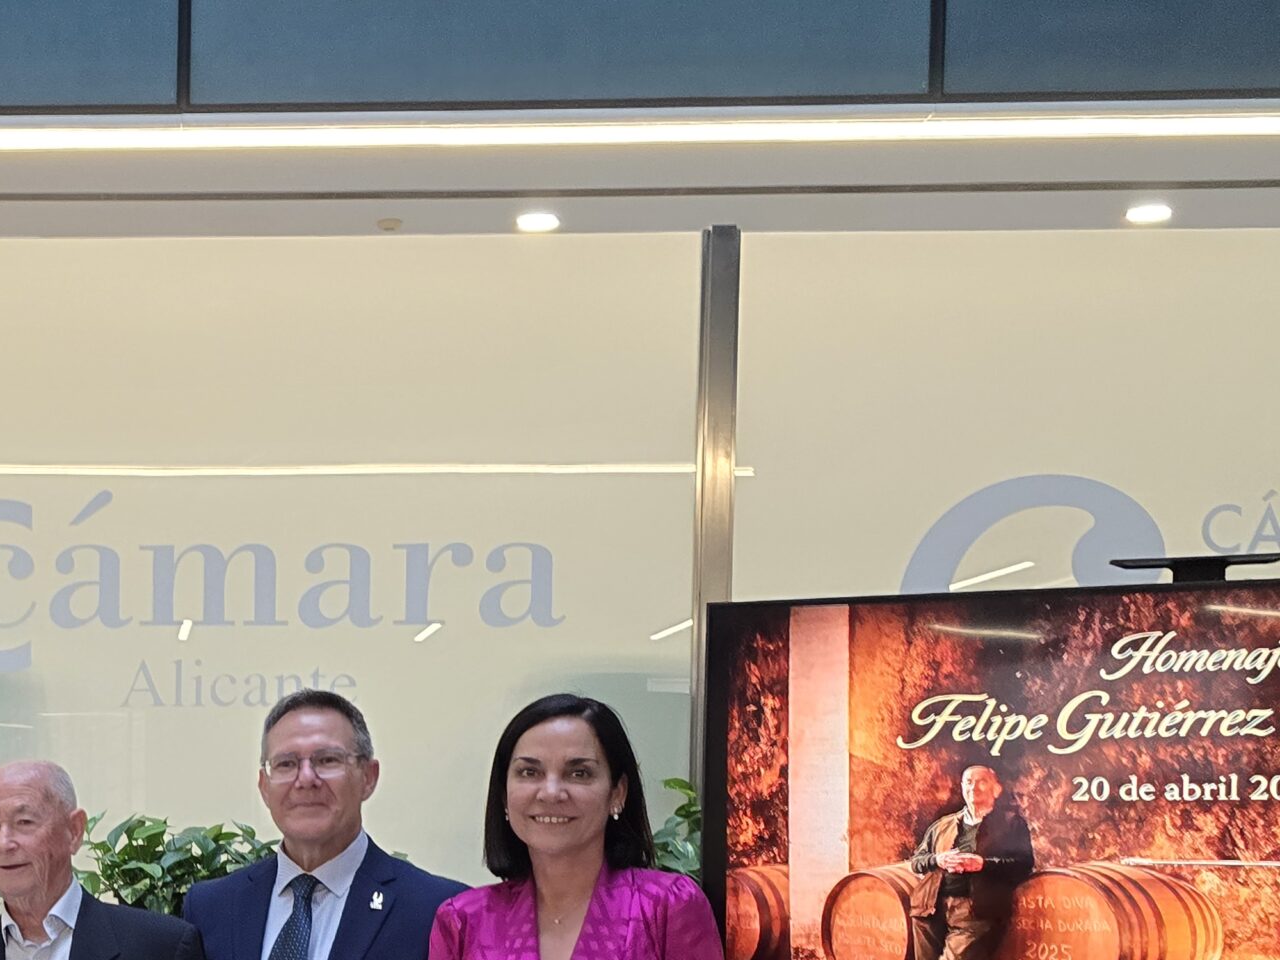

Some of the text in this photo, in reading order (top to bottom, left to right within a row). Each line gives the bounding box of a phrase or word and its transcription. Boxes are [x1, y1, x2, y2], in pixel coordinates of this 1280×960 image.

[120, 659, 358, 708] Alicante
[1100, 630, 1280, 685] Homenaj
[896, 690, 1276, 757] Felipe Gutiérrez
[1071, 776, 1111, 802] 20
[1119, 773, 1157, 802] de
[1163, 772, 1241, 801] abril
